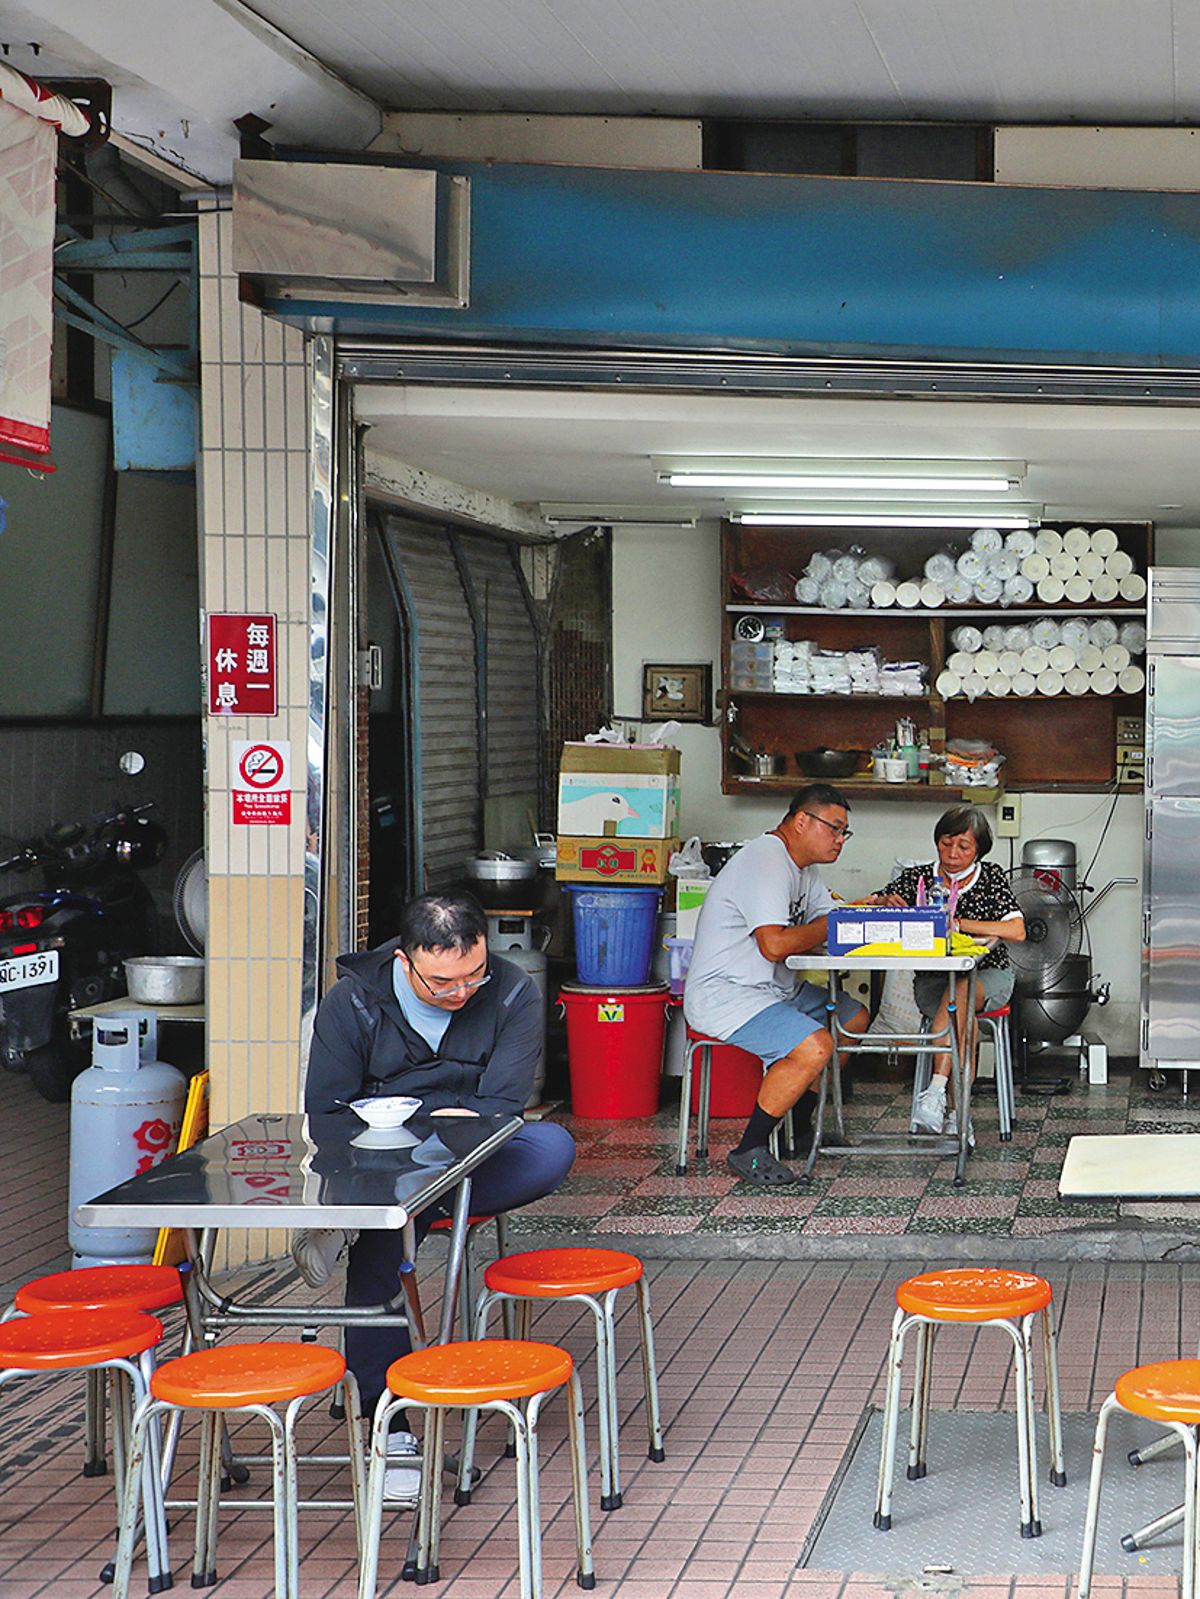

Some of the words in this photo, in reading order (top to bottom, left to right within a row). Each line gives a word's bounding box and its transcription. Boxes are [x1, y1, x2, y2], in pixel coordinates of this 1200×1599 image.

[215, 648, 239, 707] 休息
[246, 622, 271, 689] 每週一
